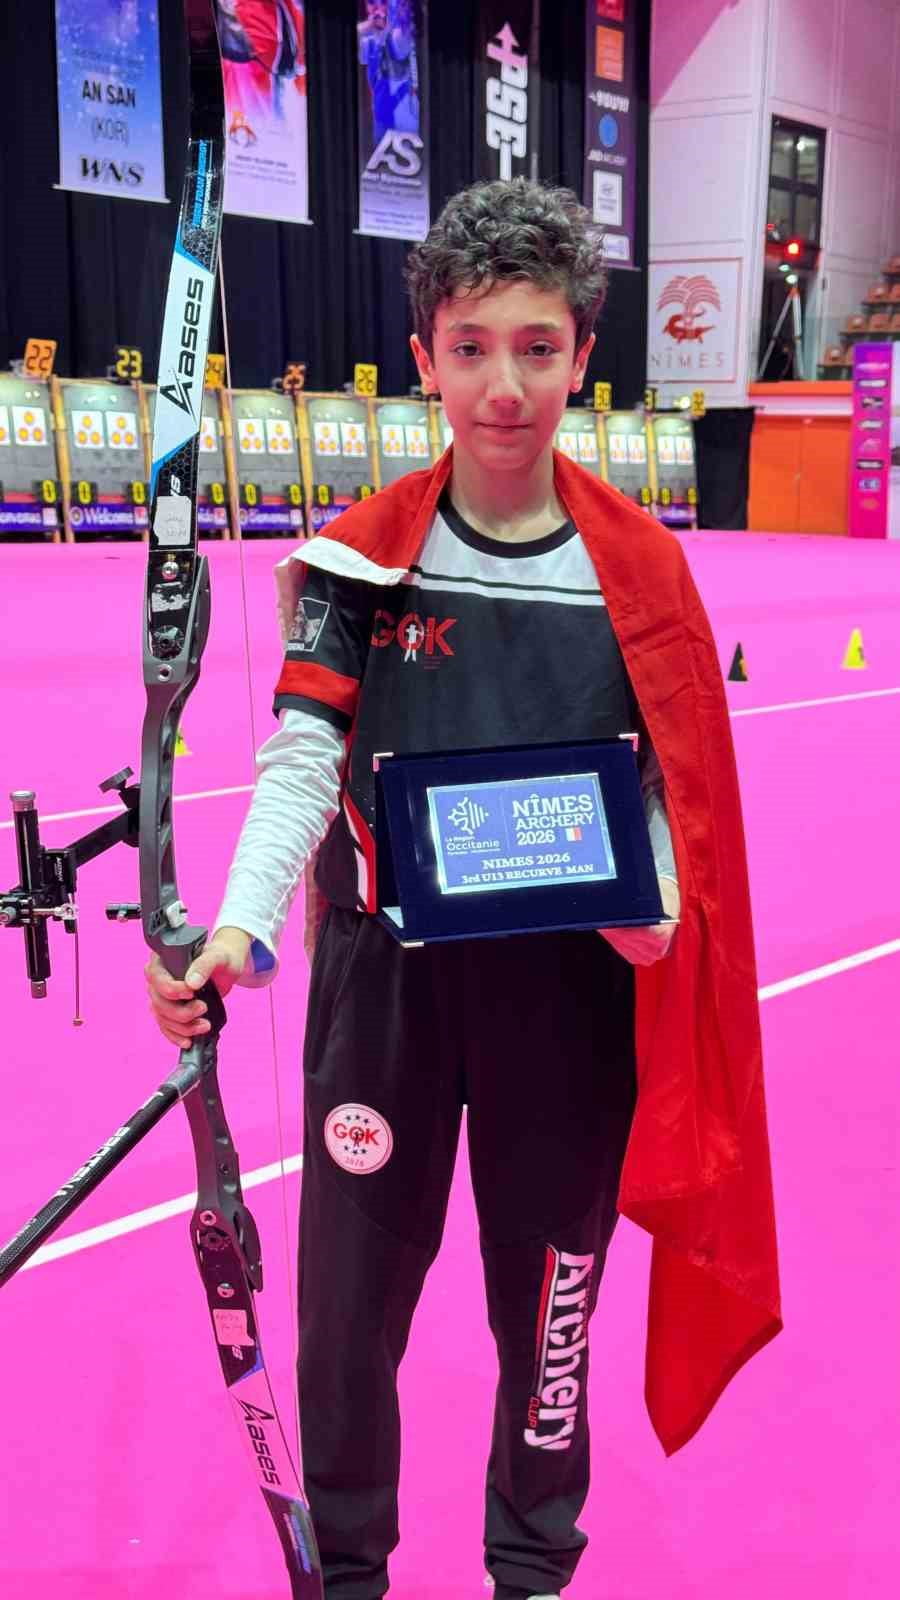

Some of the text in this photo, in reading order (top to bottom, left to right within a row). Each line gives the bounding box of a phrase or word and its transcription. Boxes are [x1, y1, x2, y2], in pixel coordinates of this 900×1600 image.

[82, 80, 137, 108] AN SAN
[91, 116, 130, 147] (KOR)
[80, 157, 144, 186] WNS
[26, 344, 52, 371] 22
[115, 349, 143, 378] 23
[650, 346, 726, 369] NÎMES
[370, 609, 457, 658] GOK
[512, 793, 595, 818] NÎMES
[515, 812, 595, 831] ARCHERY
[446, 840, 500, 851] Occitanie
[517, 829, 556, 846] 2026
[462, 863, 594, 884] 3rd U13 RECURVE MAN
[482, 852, 571, 870] NIMES 2026
[333, 1123, 380, 1146] GOK
[523, 1251, 594, 1451] Archery
